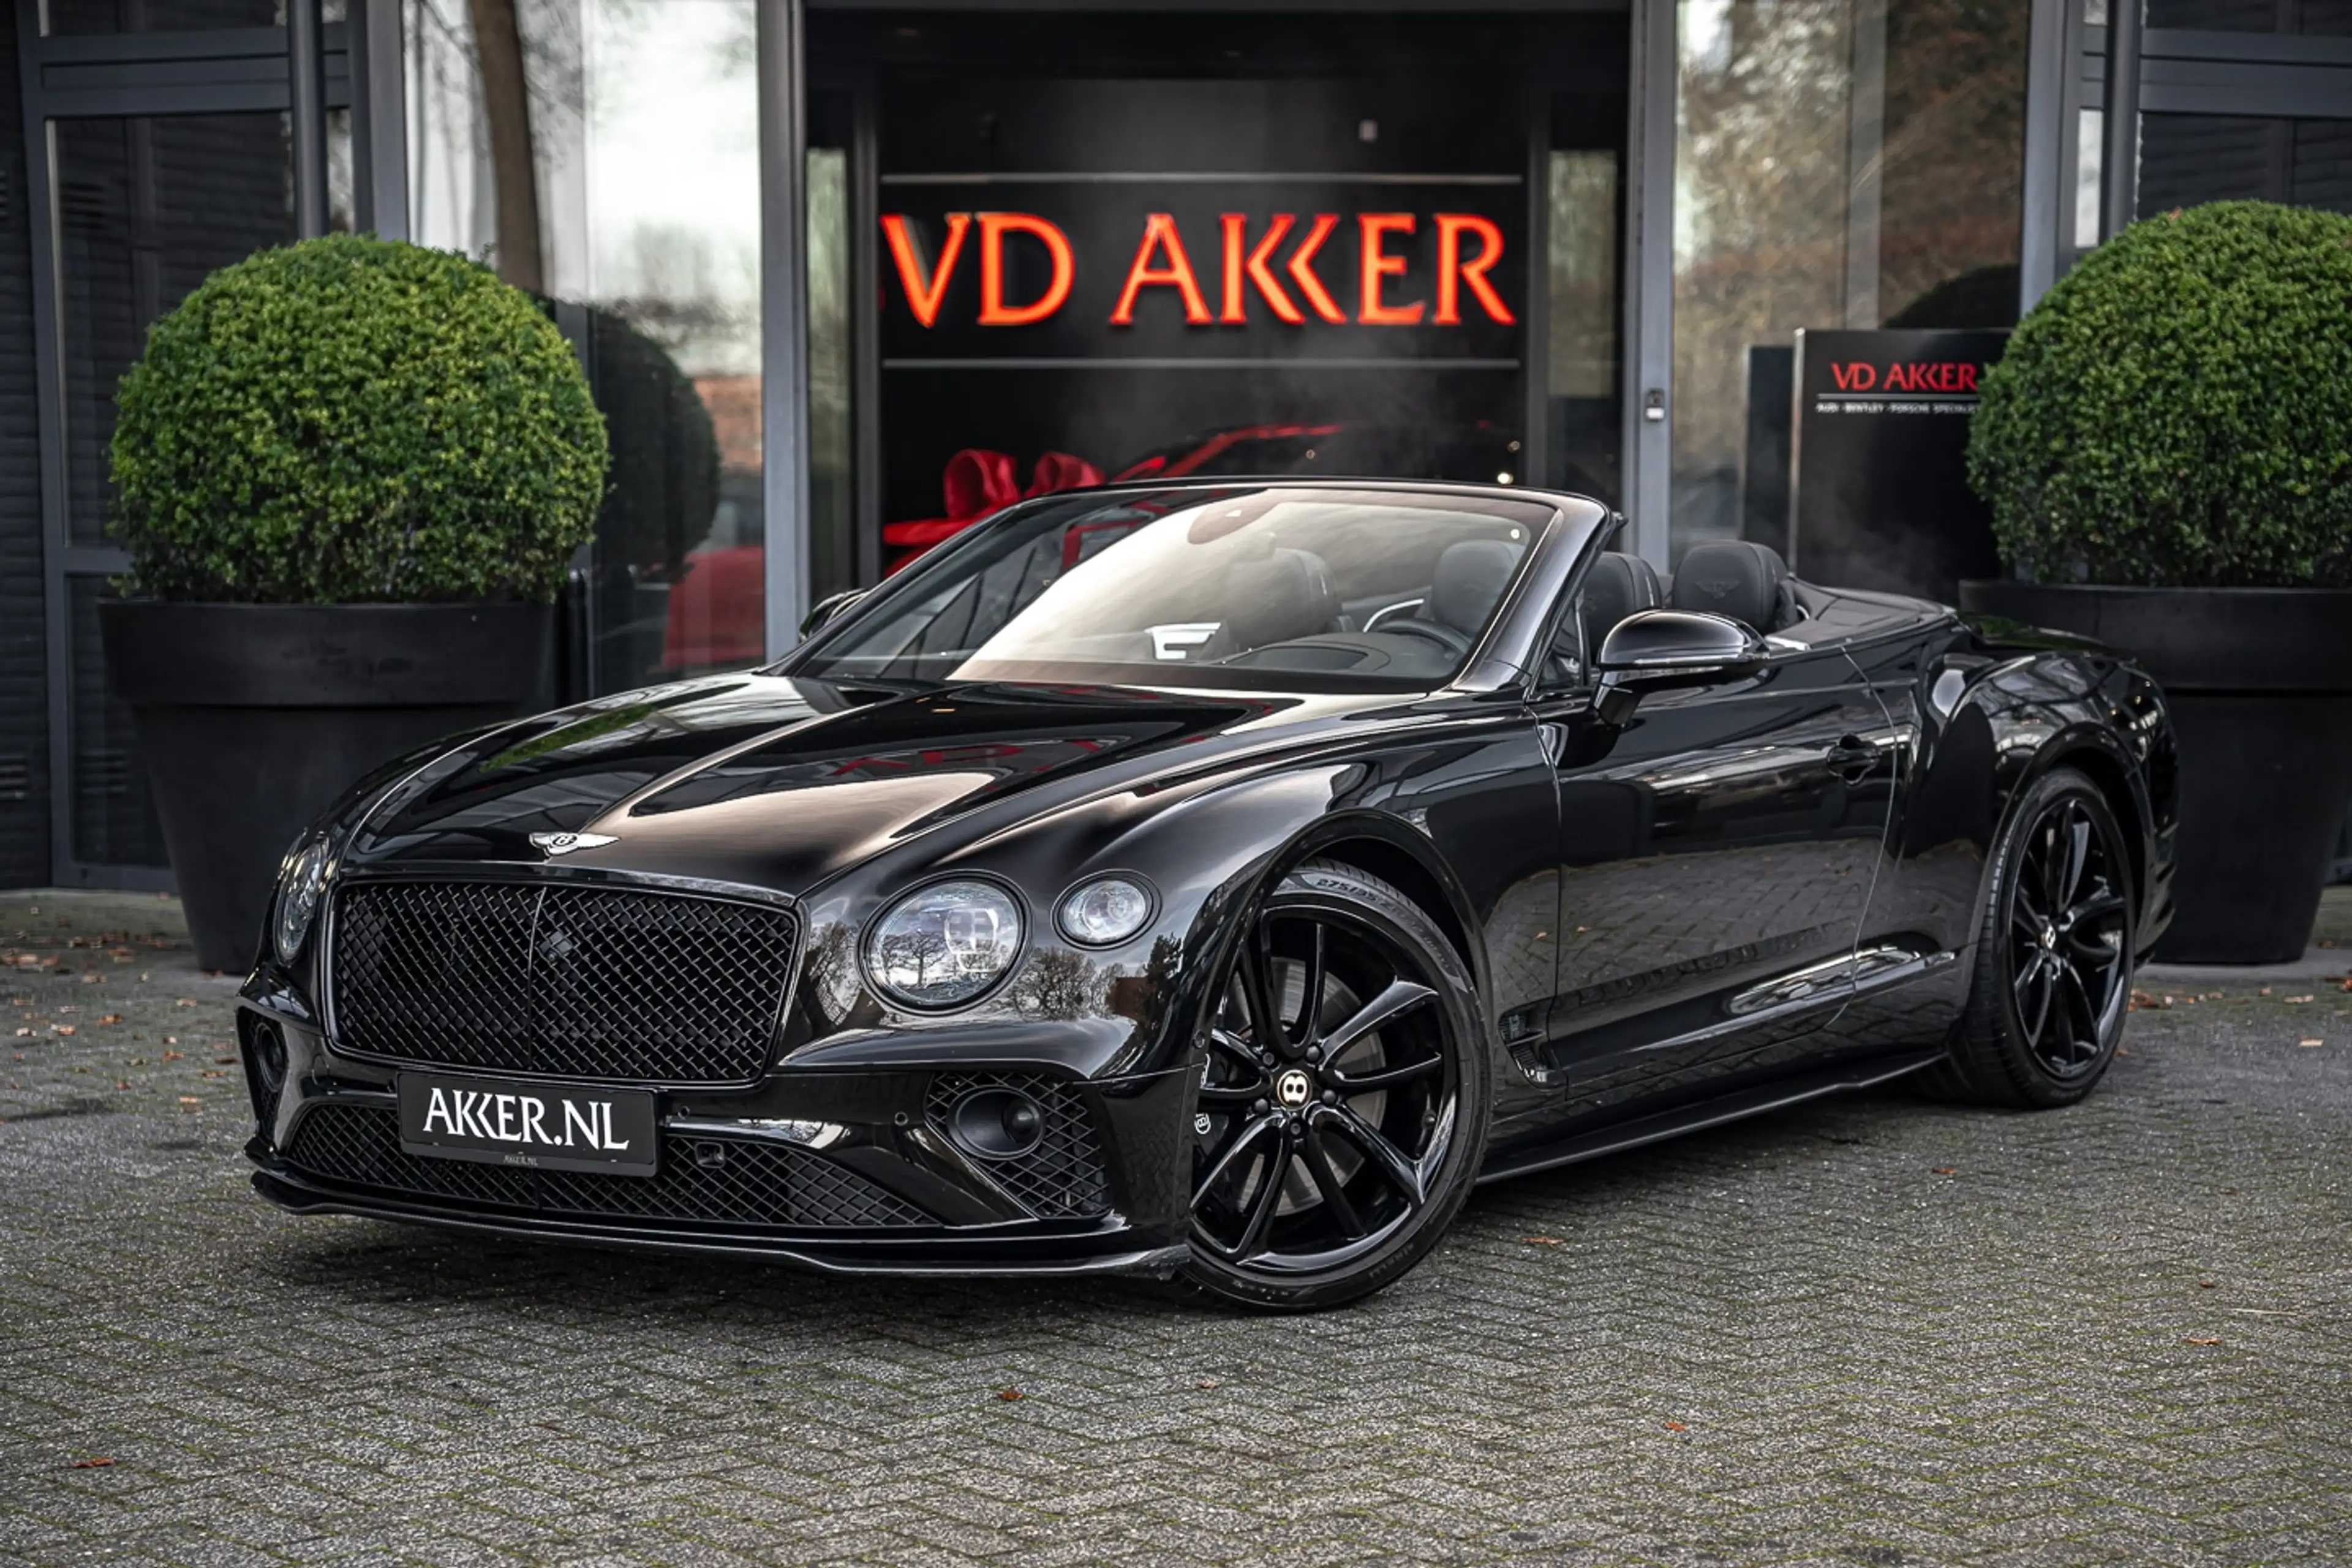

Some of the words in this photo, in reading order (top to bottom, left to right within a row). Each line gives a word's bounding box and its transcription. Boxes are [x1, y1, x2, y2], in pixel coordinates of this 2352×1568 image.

[880, 212, 1074, 328] VD
[1110, 213, 1517, 326] AKKER
[1831, 362, 1877, 391] VD
[1882, 362, 1978, 391] AKKER
[1845, 402, 1883, 413] BENTLEY
[423, 1087, 630, 1150] AKKER.NL
